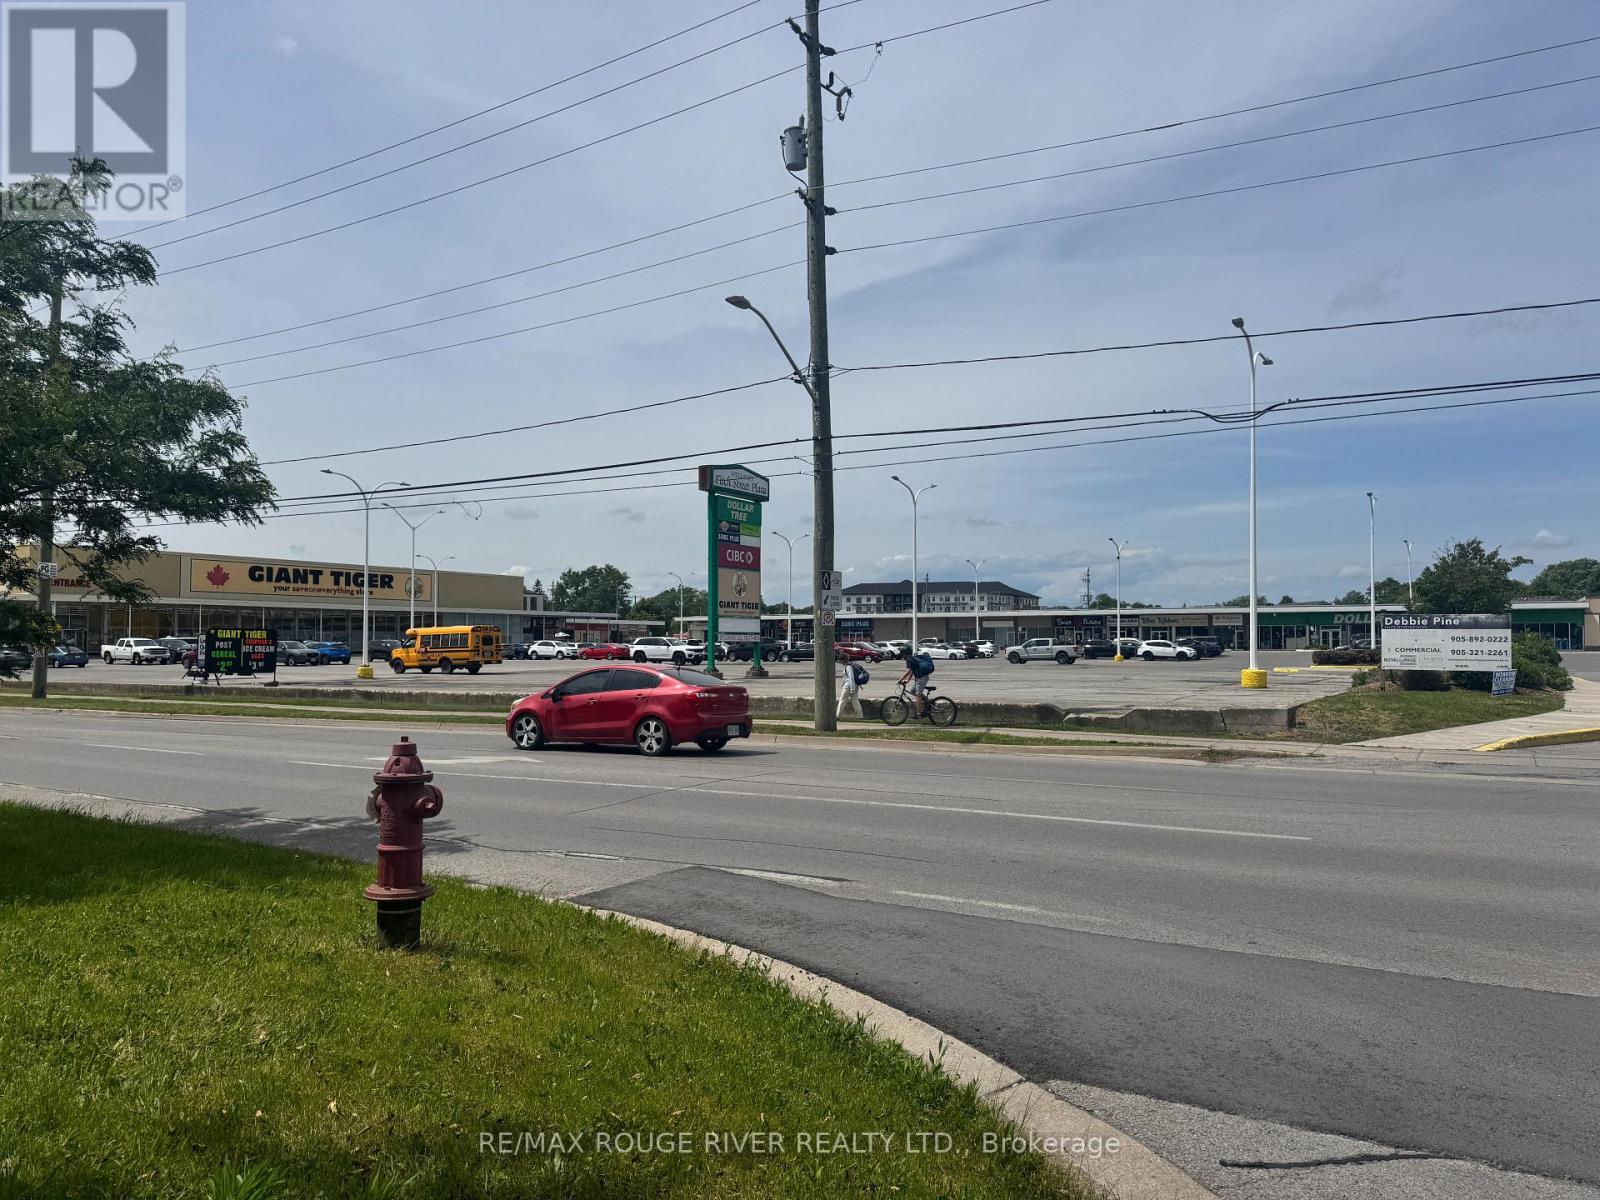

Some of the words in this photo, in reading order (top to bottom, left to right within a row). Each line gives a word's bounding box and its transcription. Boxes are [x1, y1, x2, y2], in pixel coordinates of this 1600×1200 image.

[727, 500, 754, 513] DOLLAR
[731, 510, 748, 521] TREE
[726, 549, 745, 563] CIBC
[248, 565, 323, 585] GIANT
[330, 570, 394, 589] TIGER
[51, 578, 92, 588] ENTRANCE
[719, 600, 739, 609] GIANT
[741, 602, 759, 610] TIGER
[1333, 613, 1384, 625] DOLLA
[1384, 616, 1428, 626] Debbie
[1433, 616, 1460, 626] Pine
[217, 629, 241, 638] GIANT
[244, 630, 267, 639] TIGER
[215, 641, 233, 649] POST
[254, 645, 275, 653] CREAM
